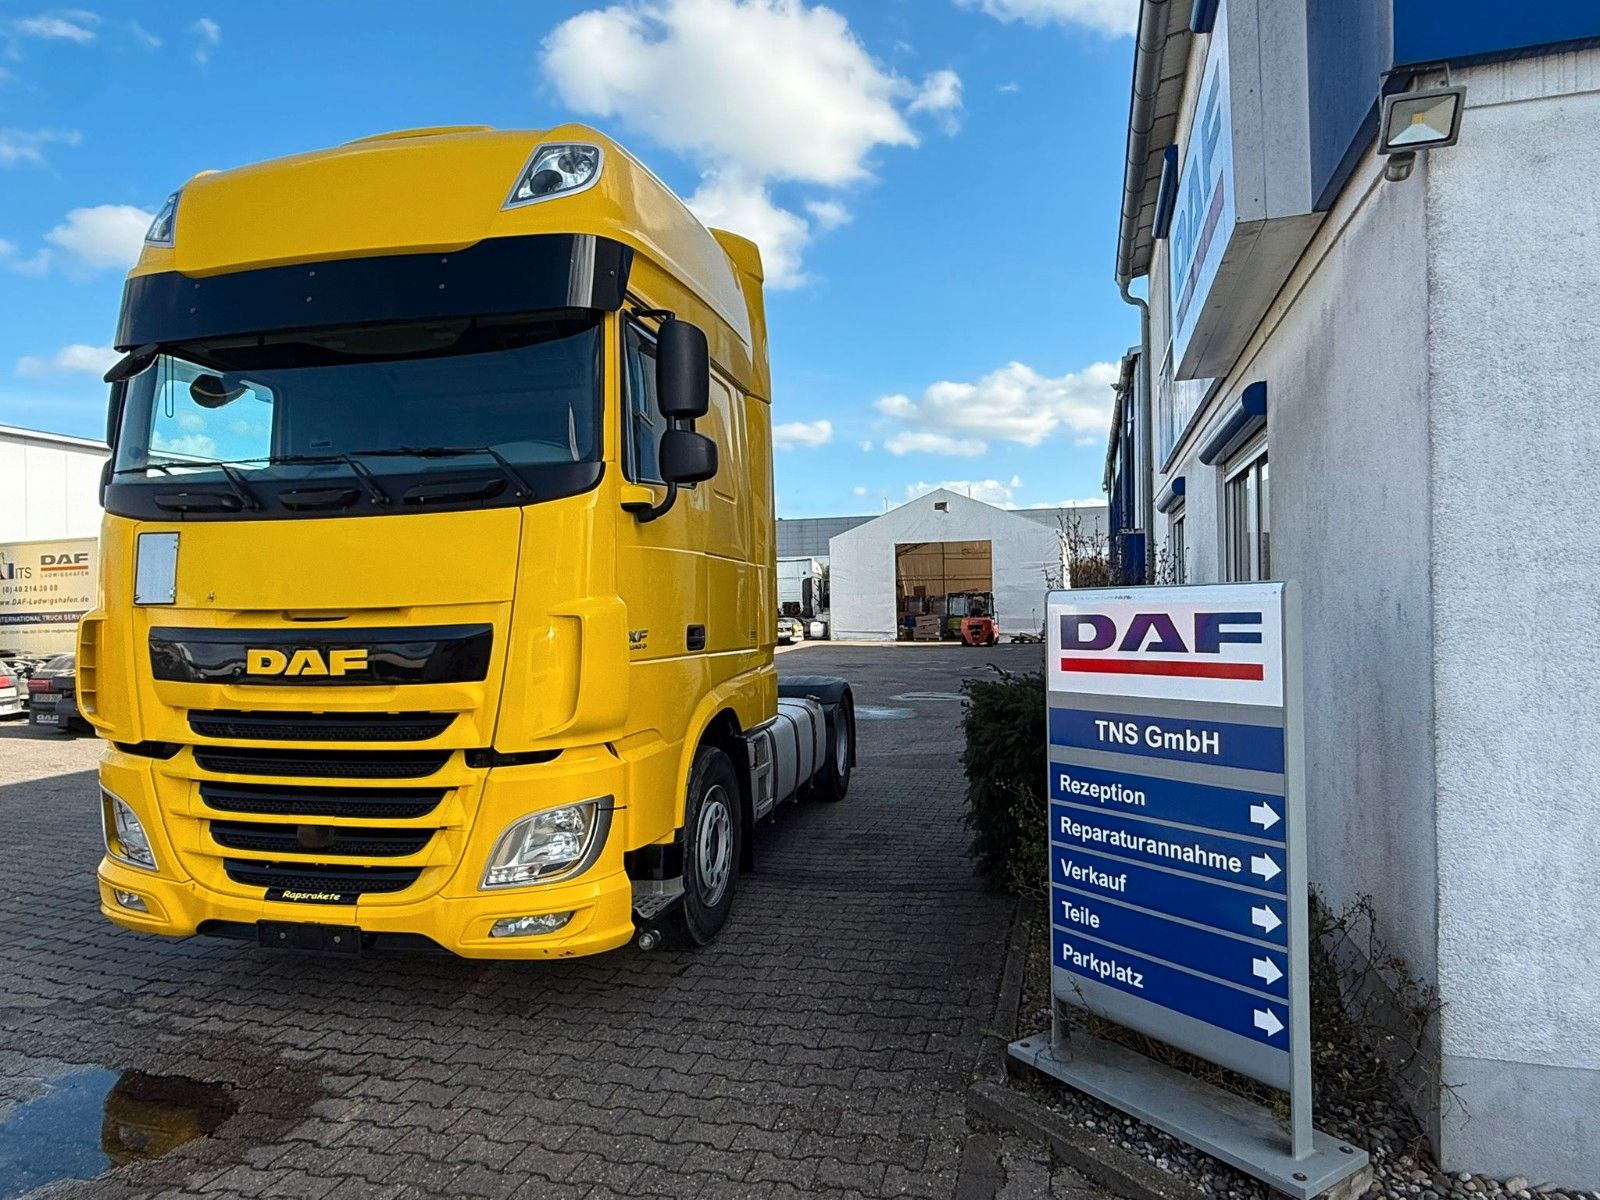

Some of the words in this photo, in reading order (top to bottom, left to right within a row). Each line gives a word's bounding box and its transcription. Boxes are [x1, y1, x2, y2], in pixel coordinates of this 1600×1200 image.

[1173, 59, 1221, 303] DAF
[40, 553, 88, 565] DAF
[1060, 612, 1262, 653] DAF
[246, 649, 368, 676] DAF
[1095, 720, 1139, 745] TNS
[1145, 726, 1220, 755] GmbH
[1060, 774, 1146, 806] Rezeption
[1060, 816, 1242, 872] Reparaturannahme
[1061, 858, 1127, 892] Verkauf
[282, 890, 341, 901] Rapsrakete
[1062, 901, 1100, 928] Teile
[1063, 943, 1144, 988] Parkplatz
